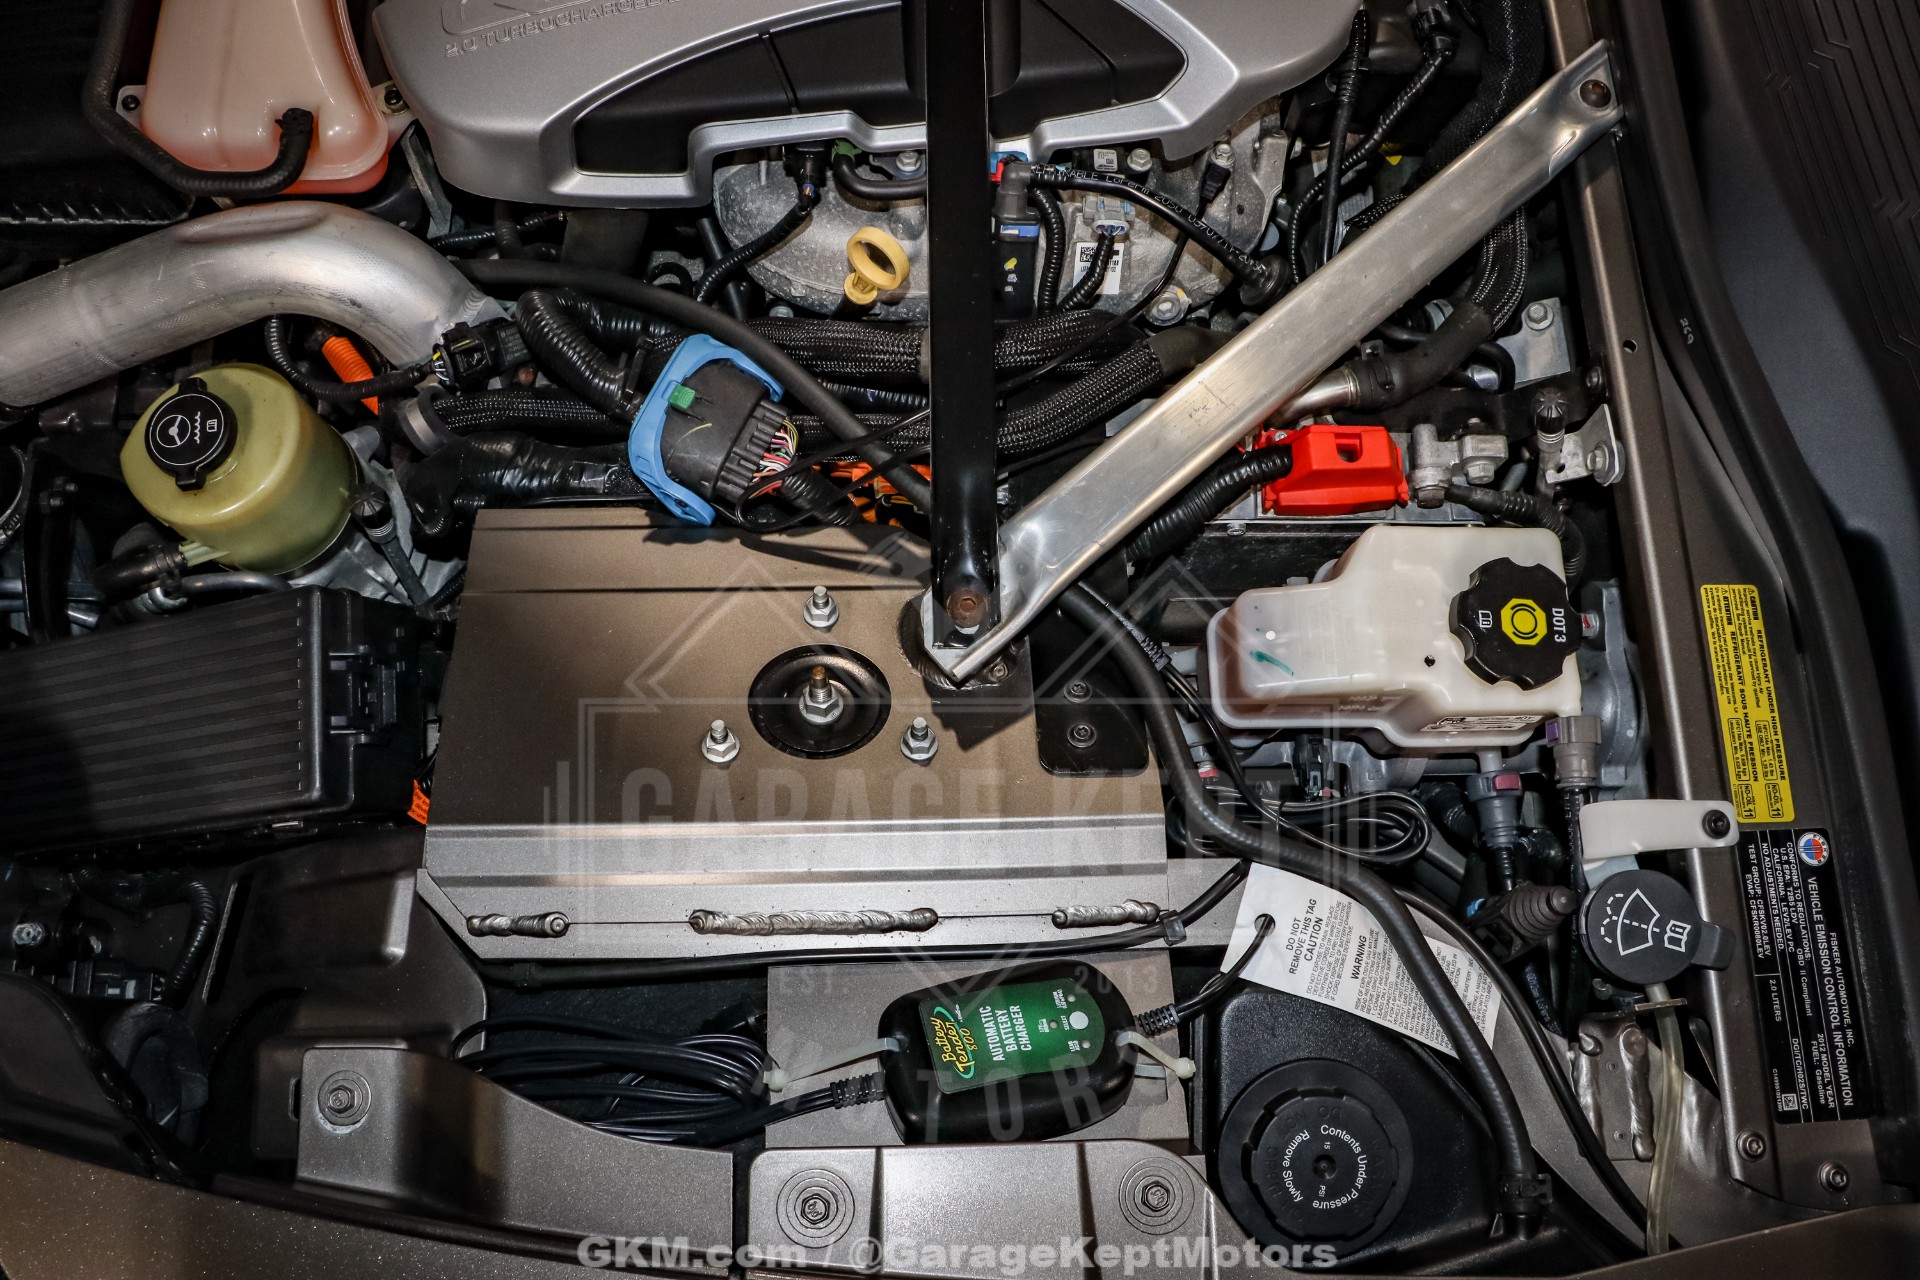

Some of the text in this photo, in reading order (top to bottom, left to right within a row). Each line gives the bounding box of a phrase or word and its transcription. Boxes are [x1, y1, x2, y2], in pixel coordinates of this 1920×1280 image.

[1552, 607, 1567, 643] DOT 3
[1723, 596, 1733, 625] ATTENTION
[1731, 632, 1743, 685] REFRIGERANT
[1744, 713, 1752, 739] HAUTE
[1748, 742, 1758, 782] PRESSION
[1750, 596, 1759, 620] CAUTION
[1757, 630, 1770, 683] REFRIGERANT
[1766, 687, 1775, 713] UNDER
[1775, 739, 1786, 780] PRESSURE
[1749, 844, 1757, 863] TEST
[1746, 874, 1754, 897] EVAP:
[1752, 866, 1761, 896] GROUP:
[1762, 843, 1784, 951] NO ADJUSTMENTS NEEDED.
[1773, 848, 1795, 952] CALIFORNIA: LEV2/LEV PC
[1787, 843, 1811, 960] CONFORMS TO REGULATIONS:
[1285, 917, 1302, 951] DO NOT
[1289, 899, 1317, 974] REMOVE THIS TAG
[1790, 908, 1798, 924] LDV
[1304, 917, 1323, 961] CAUTION
[1351, 936, 1370, 979] WARNING
[1313, 951, 1323, 972] EXPOSE
[1772, 993, 1781, 1021] LITERS
[1802, 977, 1812, 1016] Compliant
[1808, 877, 1853, 1105] VEHICLE EMISSION CONTROL INFORMATION
[1830, 933, 1854, 1047] FISKER AUTOMOTIVE, INC.
[929, 1017, 957, 1063] Battery
[945, 1020, 975, 1072] Tender
[961, 1027, 978, 1051] 800
[979, 1005, 1006, 1062] AUTOMATIC
[995, 1009, 1018, 1054] BATTERY
[1010, 1004, 1033, 1052] CHARGER
[1816, 1070, 1825, 1104] Gasoline
[1818, 1034, 1834, 1108] 2012 MODEL YEAR
[1282, 1129, 1311, 1169] Remove
[1312, 1124, 1368, 1211] Contents Under Pressure
[1282, 1169, 1304, 1203] Slowly
[1318, 1184, 1327, 1198] PSI
